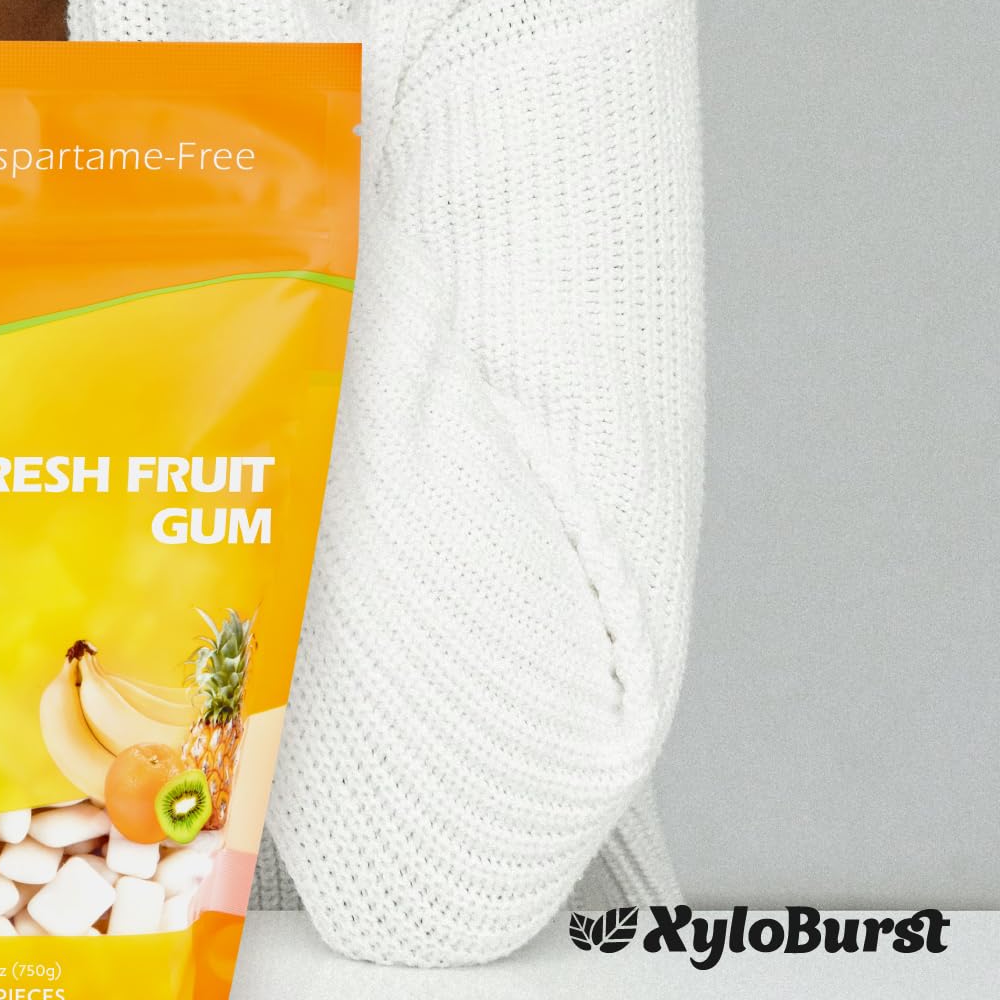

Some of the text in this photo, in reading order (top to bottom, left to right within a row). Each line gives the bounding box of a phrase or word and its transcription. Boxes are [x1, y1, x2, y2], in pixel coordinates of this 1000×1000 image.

[126, 456, 275, 493] FRUIT
[151, 507, 272, 545] GUM
[11, 961, 62, 981] (750g)
